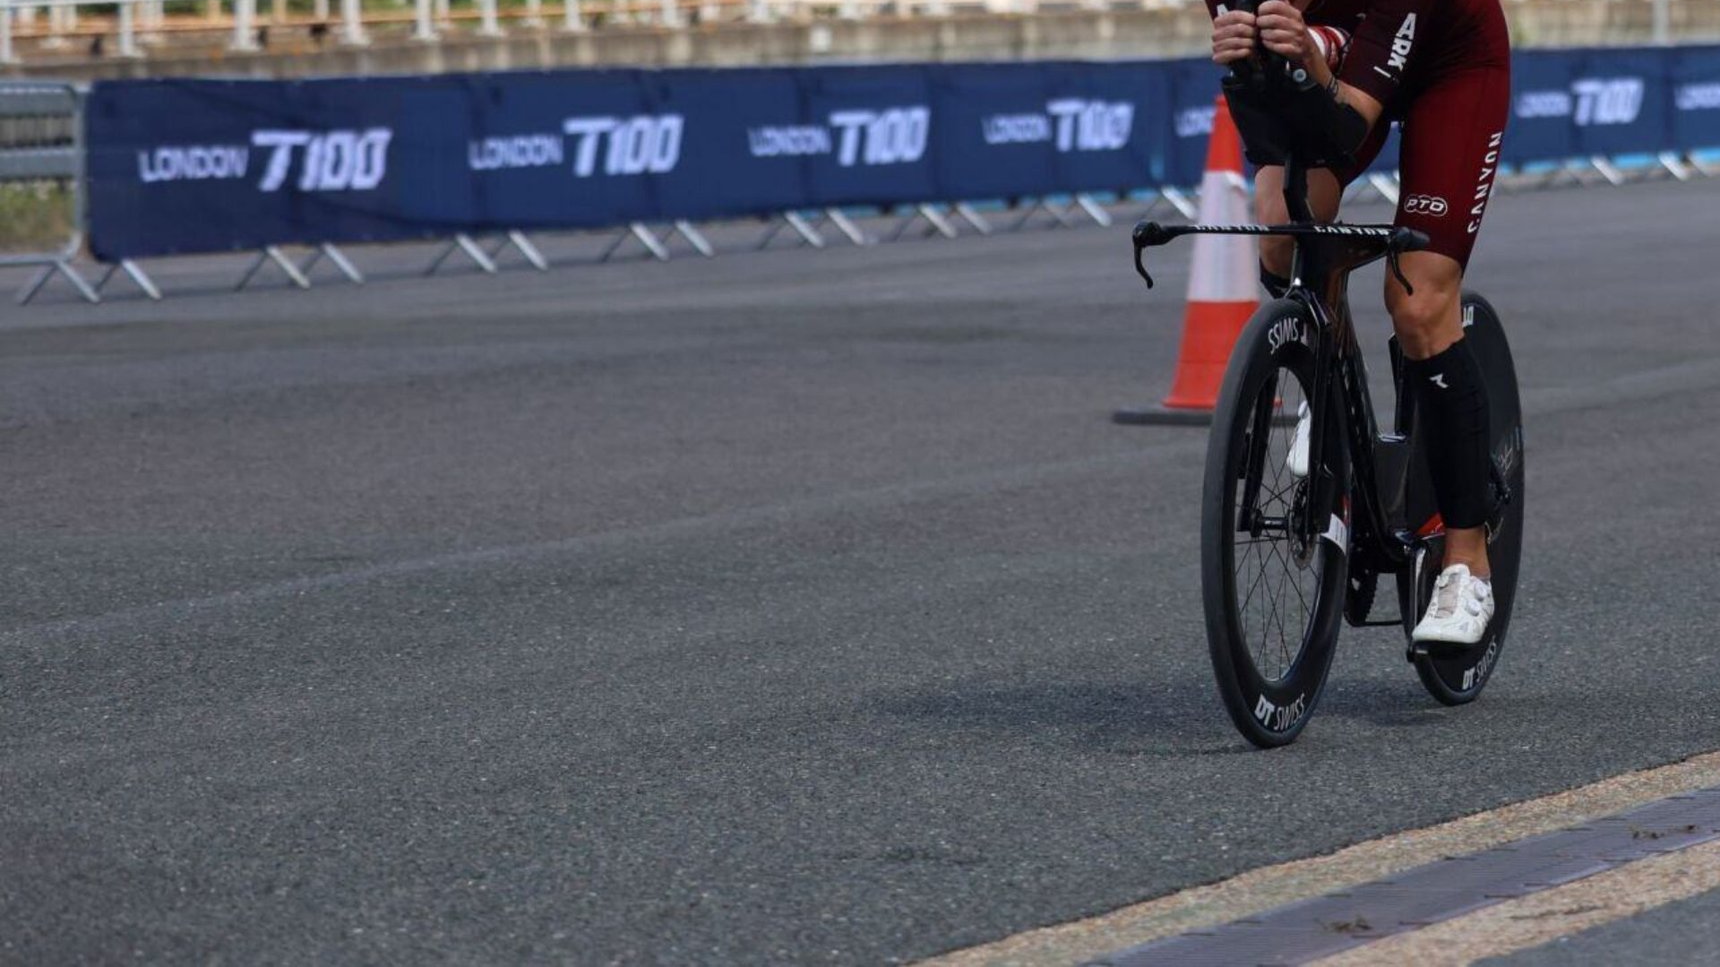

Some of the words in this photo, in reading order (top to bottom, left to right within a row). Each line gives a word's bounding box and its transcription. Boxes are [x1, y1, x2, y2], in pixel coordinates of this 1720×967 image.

[469, 134, 562, 171] LONDON
[563, 114, 684, 177] T100
[829, 106, 930, 166] T100
[1046, 98, 1134, 152] T100
[138, 144, 248, 183] LONDON
[250, 127, 393, 192] T100
[1467, 131, 1502, 233] CANYON
[1406, 198, 1444, 212] PTO
[1268, 317, 1299, 355] SWISS
[1254, 693, 1275, 726] DT
[1273, 692, 1305, 731] SWISS
